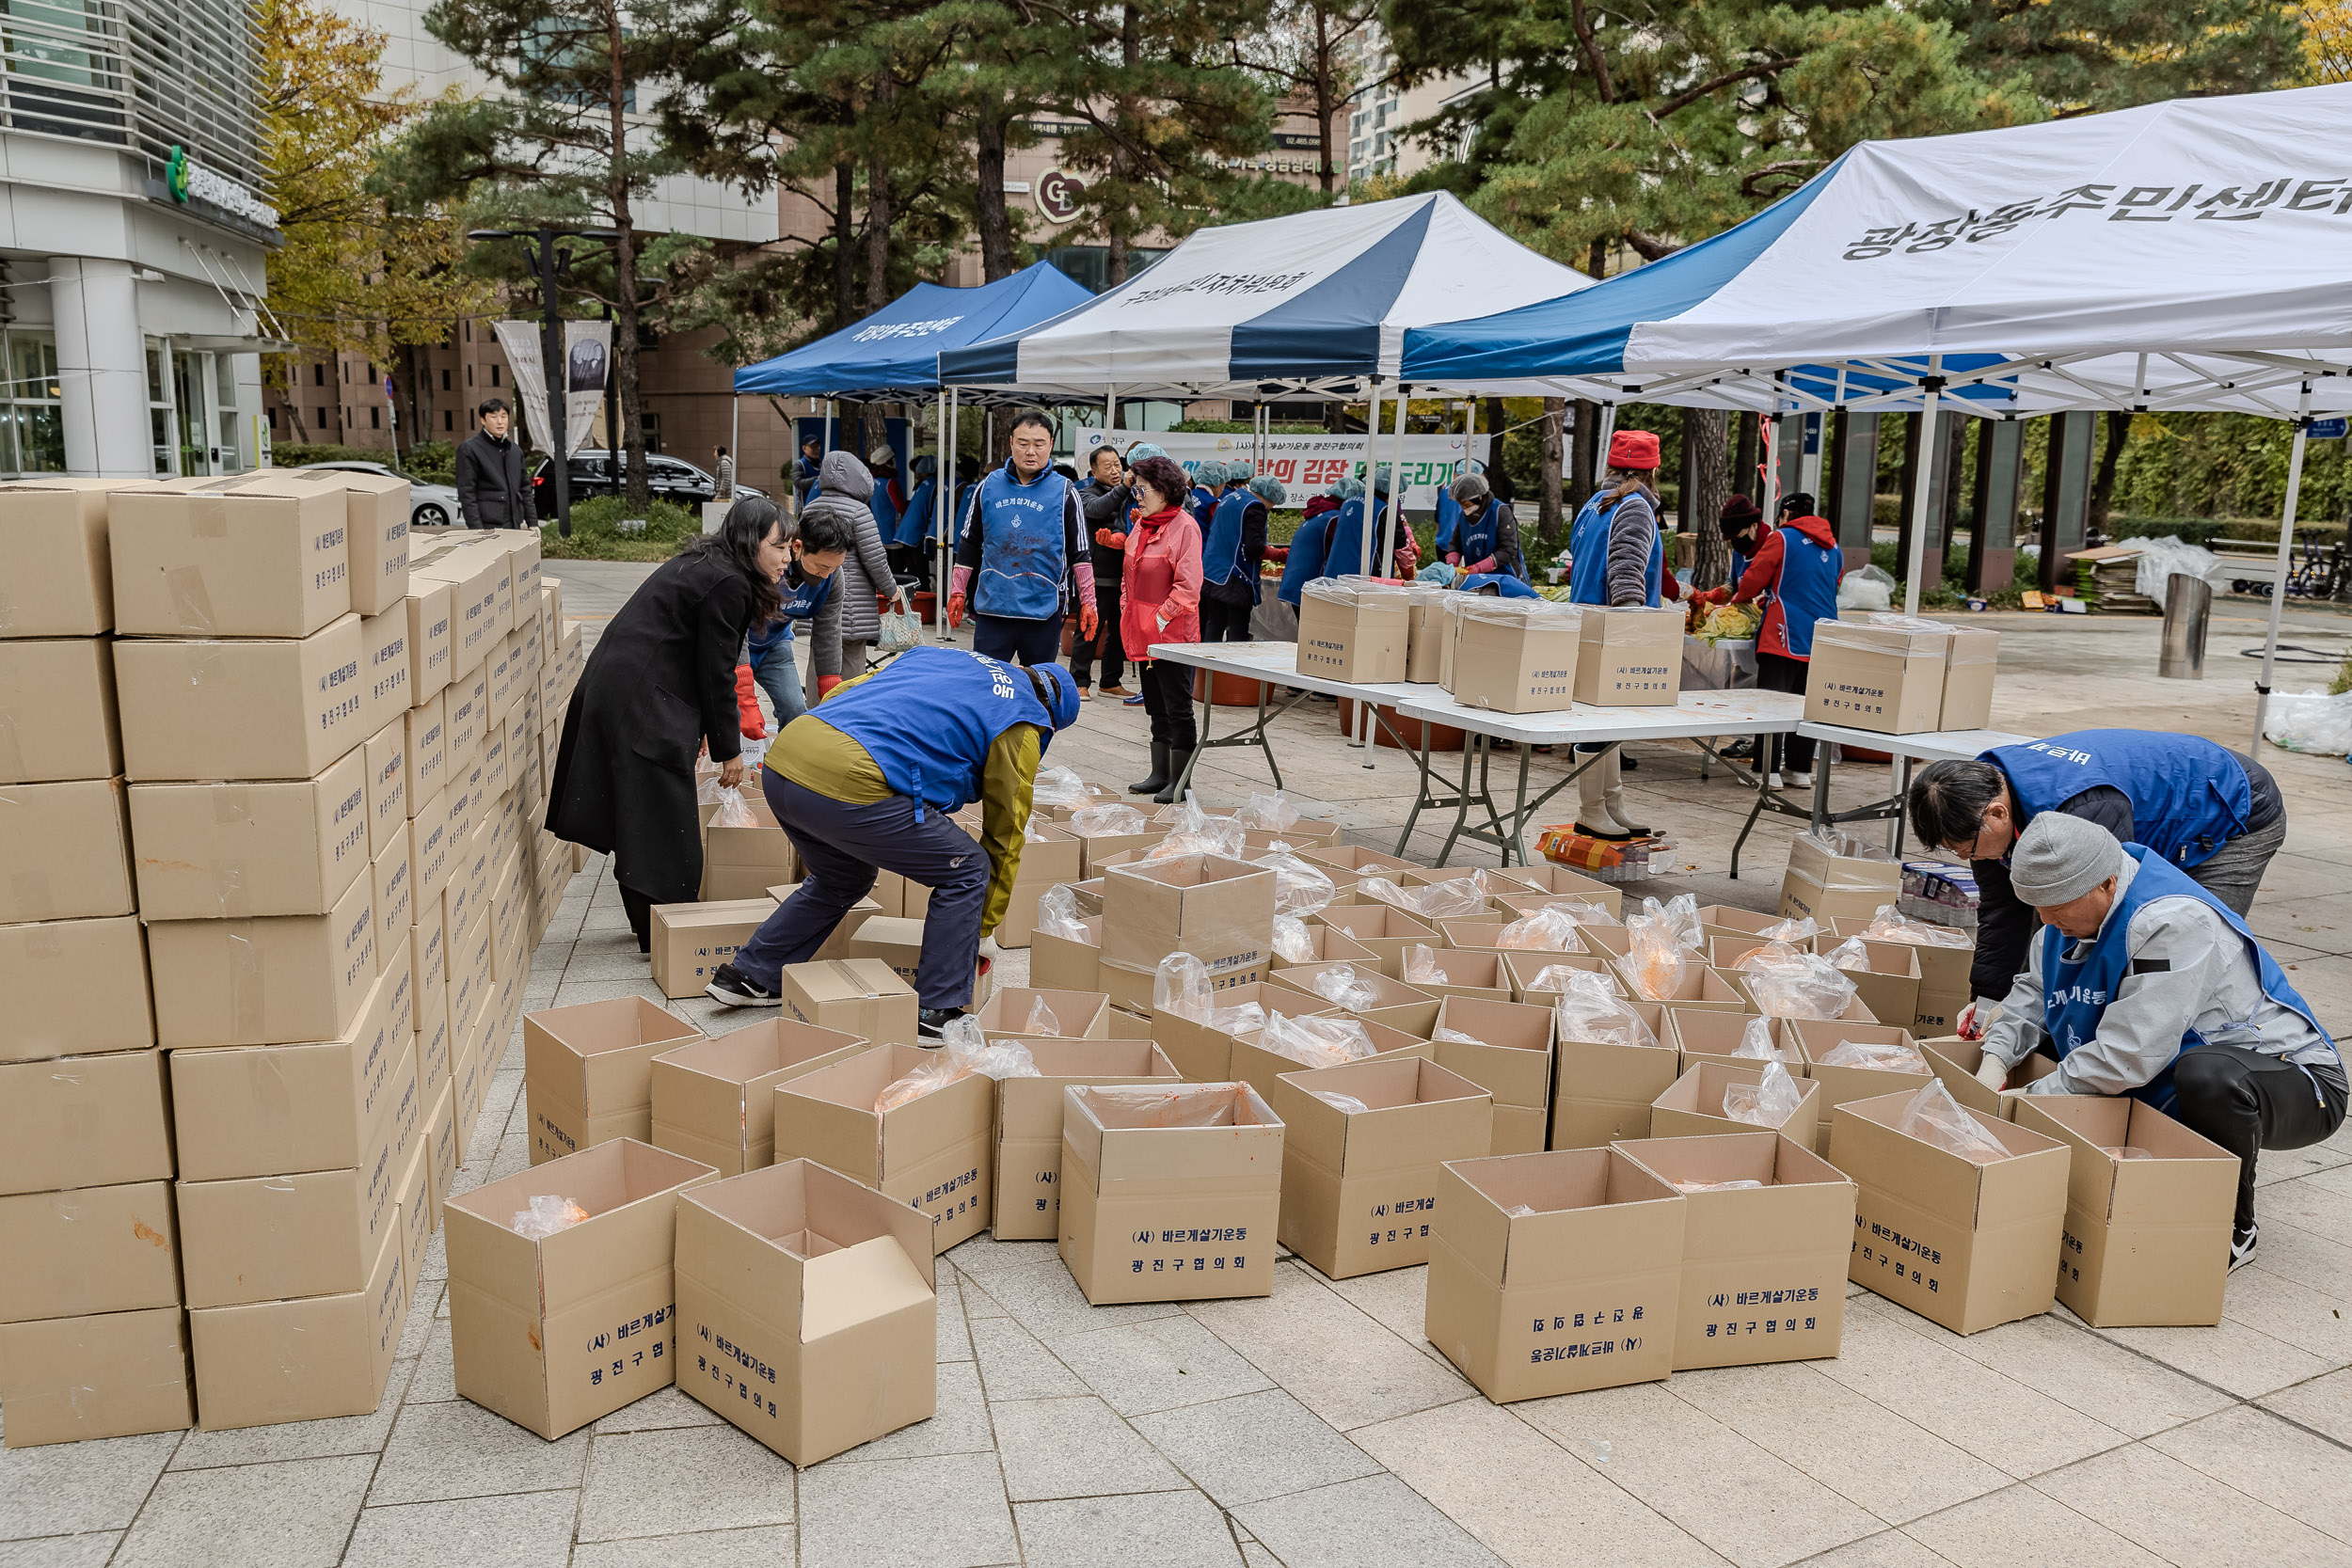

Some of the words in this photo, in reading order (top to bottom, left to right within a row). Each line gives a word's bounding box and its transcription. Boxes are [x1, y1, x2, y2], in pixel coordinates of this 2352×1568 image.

[1842, 178, 2352, 261] 광장동주민센터
[1312, 441, 1364, 451] 광진구협의회
[1302, 459, 1349, 484] 김장
[995, 498, 1044, 513] 바르게살기운동
[1629, 664, 1669, 675] 바르게살기운동
[1839, 683, 1885, 698] 바르게살기운동
[694, 947, 709, 958] (사)
[546, 1116, 577, 1153] 바르게살기운동
[926, 1167, 978, 1204] 바르게살기운동
[1035, 1171, 1057, 1185] (사)
[1370, 1201, 1391, 1219] (사)
[1131, 1230, 1155, 1245] (사)
[1161, 1226, 1248, 1243] 바르게살기운동
[1870, 1219, 1942, 1266] 바르게살기운동
[1131, 1255, 1247, 1274] 광진구협의회
[1706, 1291, 1730, 1307] (사)
[1735, 1285, 1820, 1307] 바르게살기운동
[1704, 1316, 1817, 1338] 광진구협의회
[586, 1333, 612, 1354] (사)
[1530, 1338, 1614, 1365] 바르게살기운동
[1619, 1338, 1643, 1354] (사)
[696, 1323, 712, 1343] (사)
[716, 1335, 777, 1386] 바르게살기운동
[697, 1354, 778, 1420] 광진구협의회
